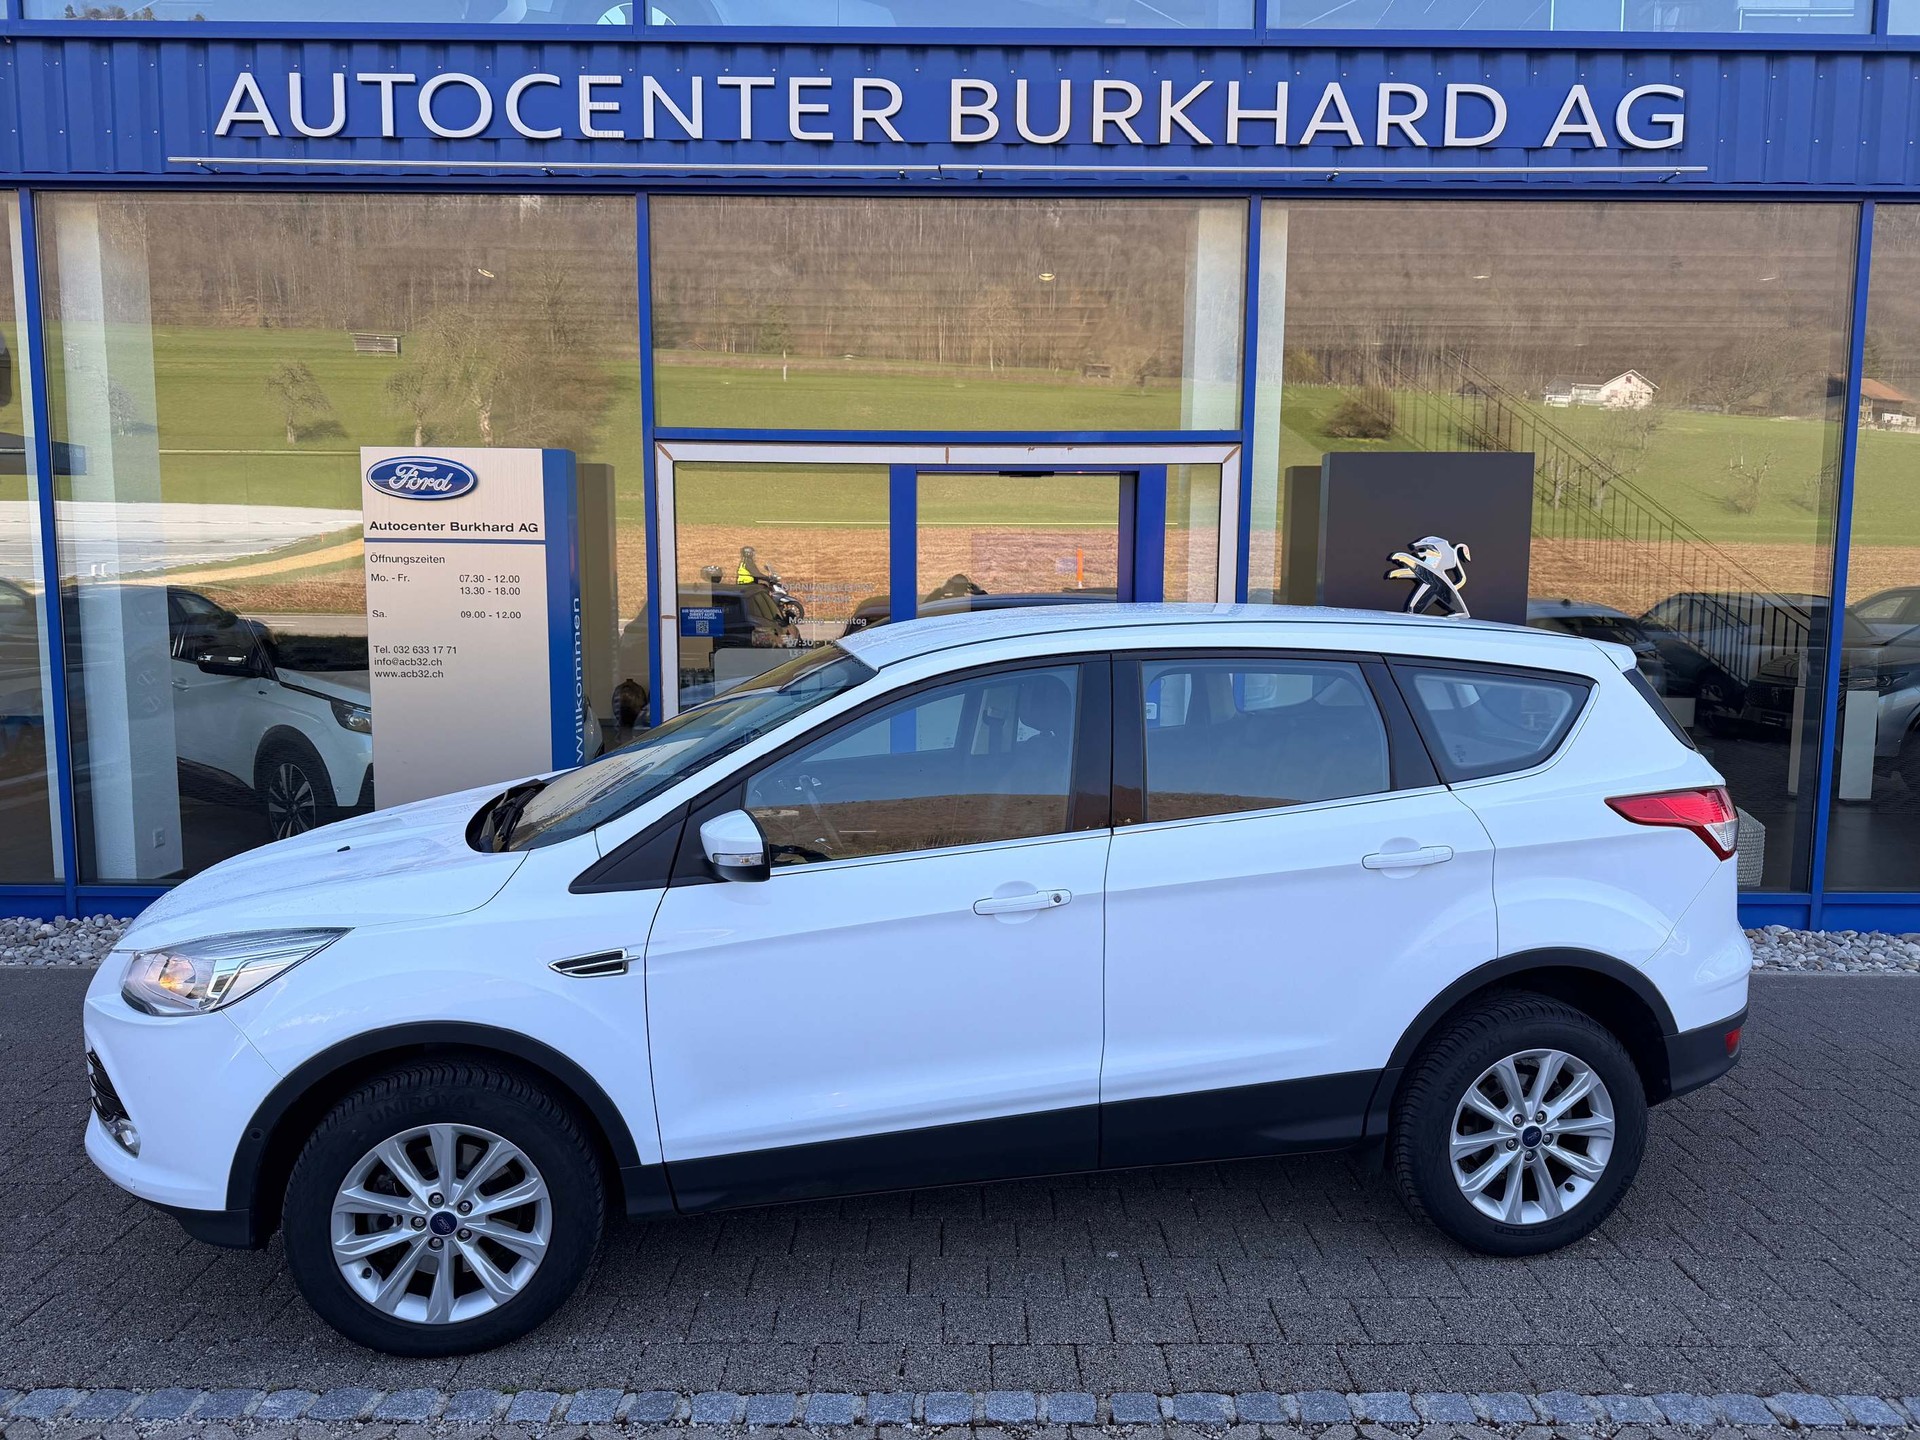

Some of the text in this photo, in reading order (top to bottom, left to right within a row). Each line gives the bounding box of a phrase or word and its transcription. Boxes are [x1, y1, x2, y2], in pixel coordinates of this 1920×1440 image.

[214, 72, 1686, 149] AUTOCENTER BURKHARD AG
[388, 463, 454, 491] Ford
[369, 520, 539, 533] Autocenter Burkhard AG
[370, 553, 446, 565] Öffnungszeiten
[371, 573, 389, 583] Mo.
[398, 573, 410, 583] Fr.
[459, 574, 485, 584] 07.30
[494, 574, 520, 584] 12.00
[459, 586, 485, 596] 13.30
[495, 586, 521, 596] 18.00
[372, 609, 387, 618] Sa.
[460, 610, 486, 620] 09.00
[495, 610, 521, 620] 12.00
[373, 645, 457, 654] Tel. 032 633 17 71
[374, 656, 442, 667] info@acb32.ch
[375, 668, 443, 679] www.acb32.ch
